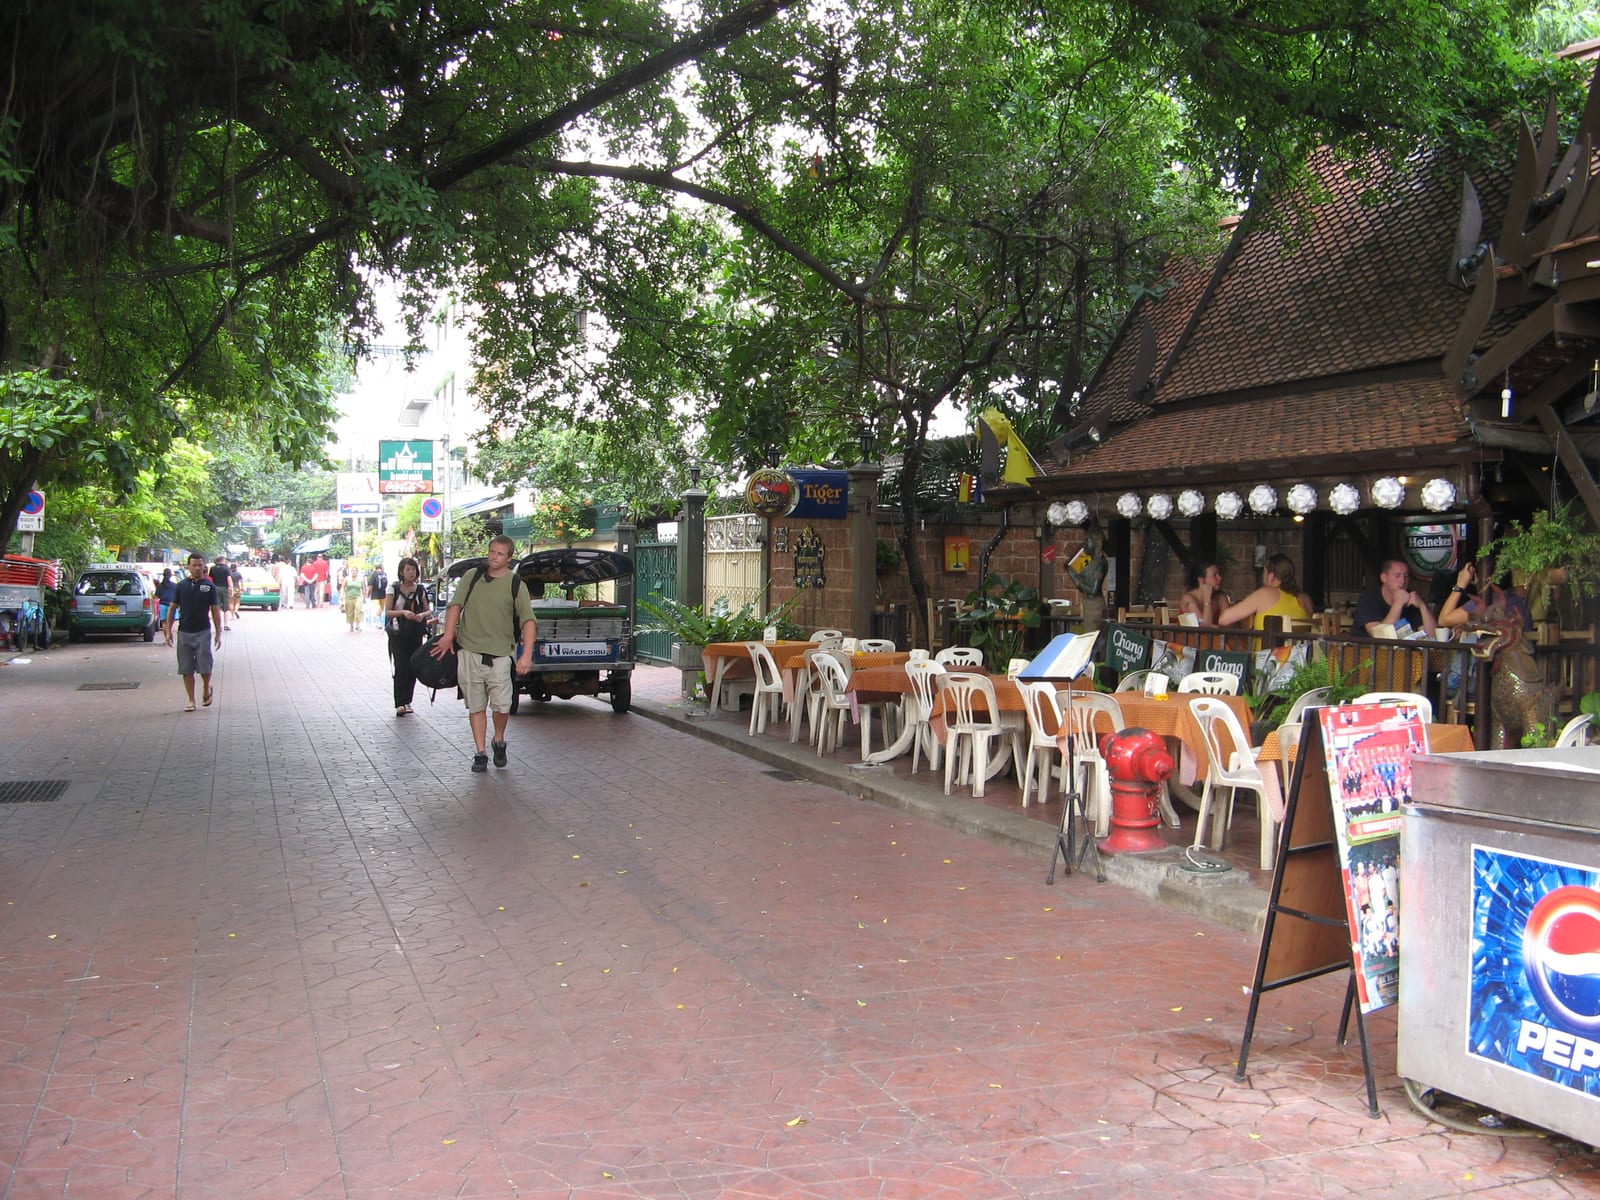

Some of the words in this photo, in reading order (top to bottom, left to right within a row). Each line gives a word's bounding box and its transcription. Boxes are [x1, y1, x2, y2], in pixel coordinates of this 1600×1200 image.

[803, 484, 842, 504] Tiger
[1408, 536, 1452, 547] Heineken
[1112, 629, 1144, 659] Chang
[1205, 654, 1244, 679] Chang
